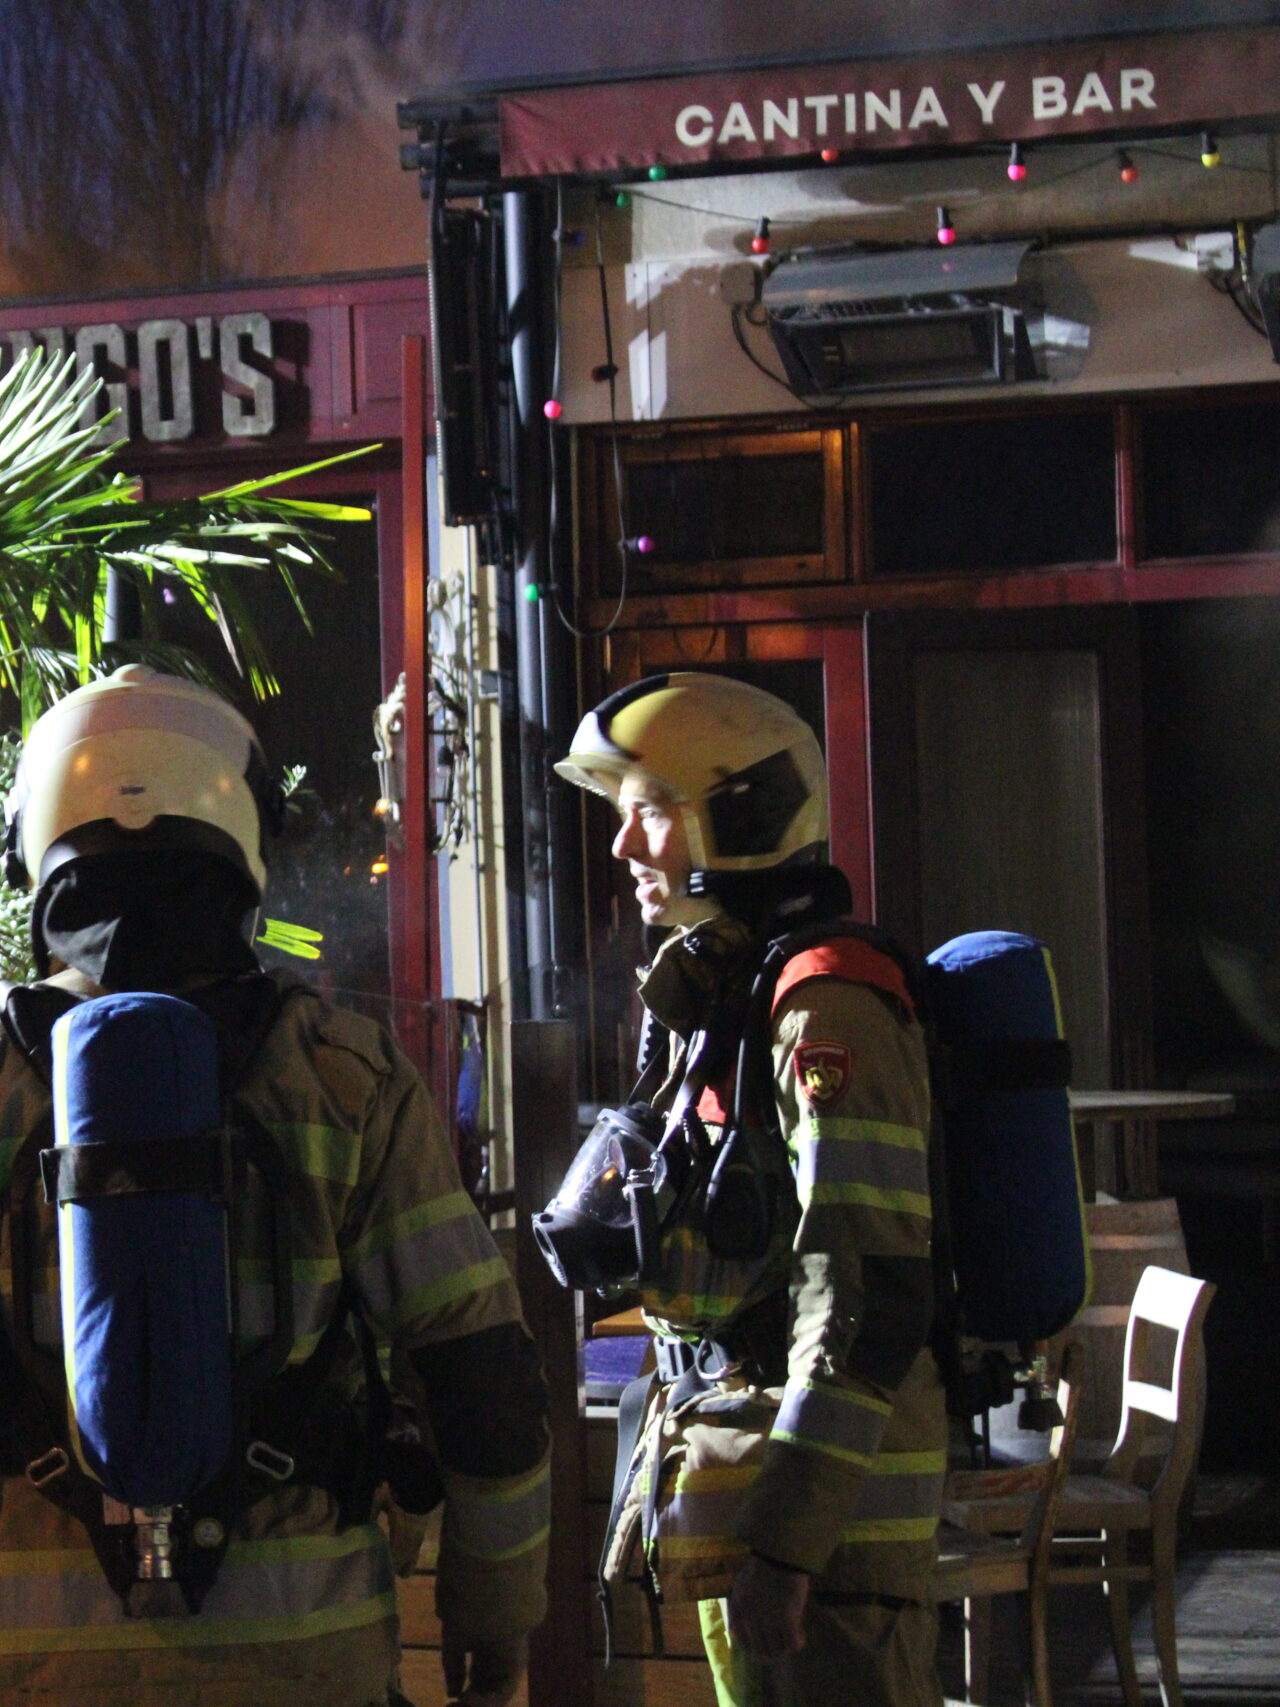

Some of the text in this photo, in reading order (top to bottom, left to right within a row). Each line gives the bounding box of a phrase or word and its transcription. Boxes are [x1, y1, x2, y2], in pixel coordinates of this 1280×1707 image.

[674, 67, 1158, 147] CANTINA Y BAR
